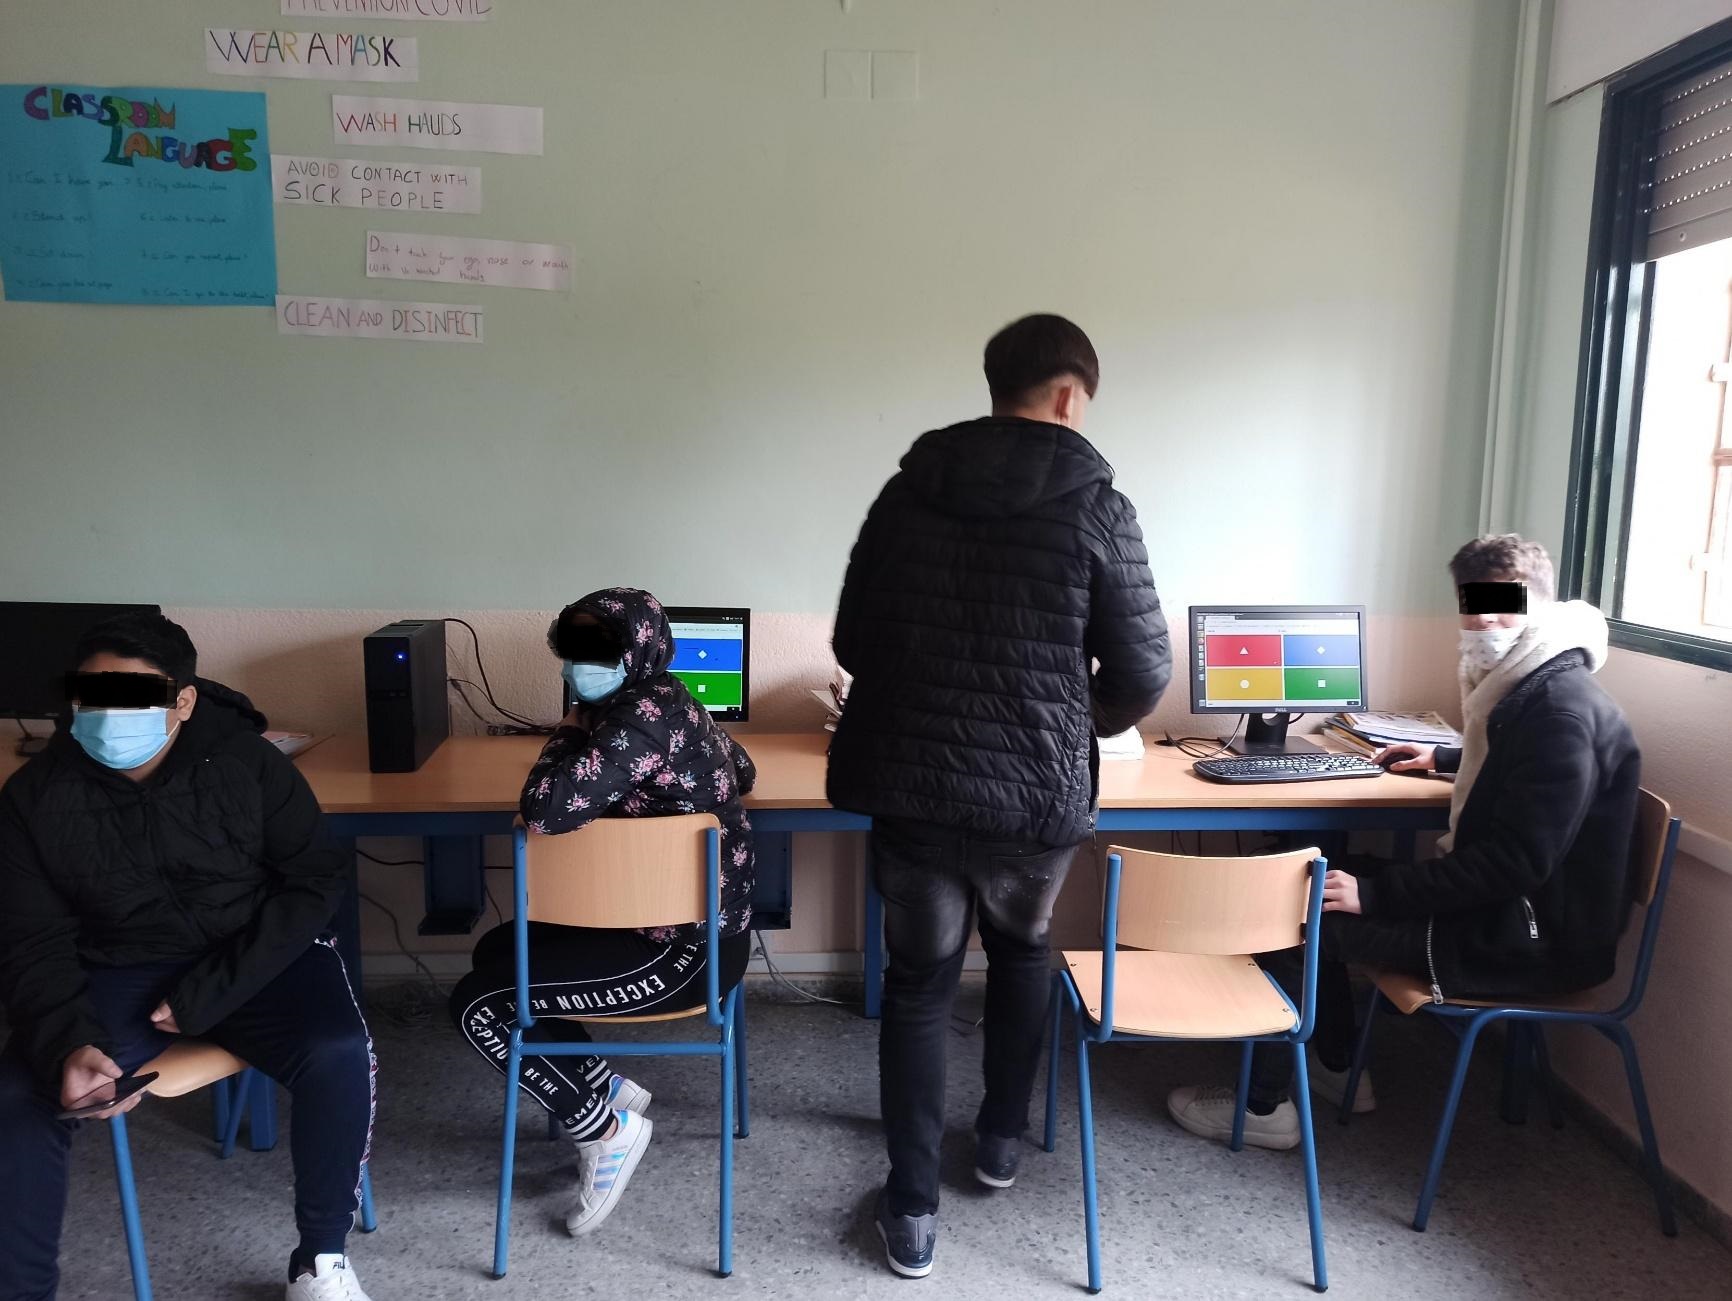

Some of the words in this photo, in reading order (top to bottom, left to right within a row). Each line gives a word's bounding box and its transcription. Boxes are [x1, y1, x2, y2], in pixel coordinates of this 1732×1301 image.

[210, 30, 300, 64] WEAR
[308, 33, 332, 65] A
[336, 34, 401, 68] MASK
[24, 86, 176, 130] CLASSROOM
[336, 112, 397, 133] WASH
[102, 125, 257, 172] LANGUAGE
[287, 160, 339, 178] AVOID
[351, 165, 422, 184] CONTACT
[430, 173, 468, 185] WITH
[284, 181, 341, 205] SICK
[361, 188, 445, 210] PEOPLE
[284, 301, 350, 329] CLEAN
[356, 311, 383, 328] AND
[391, 309, 483, 339] DISINFECT
[532, 999, 548, 1010] BE
[556, 974, 666, 1010] EXCEPTION
[524, 1067, 541, 1081] BE
[539, 1078, 559, 1095] THE
